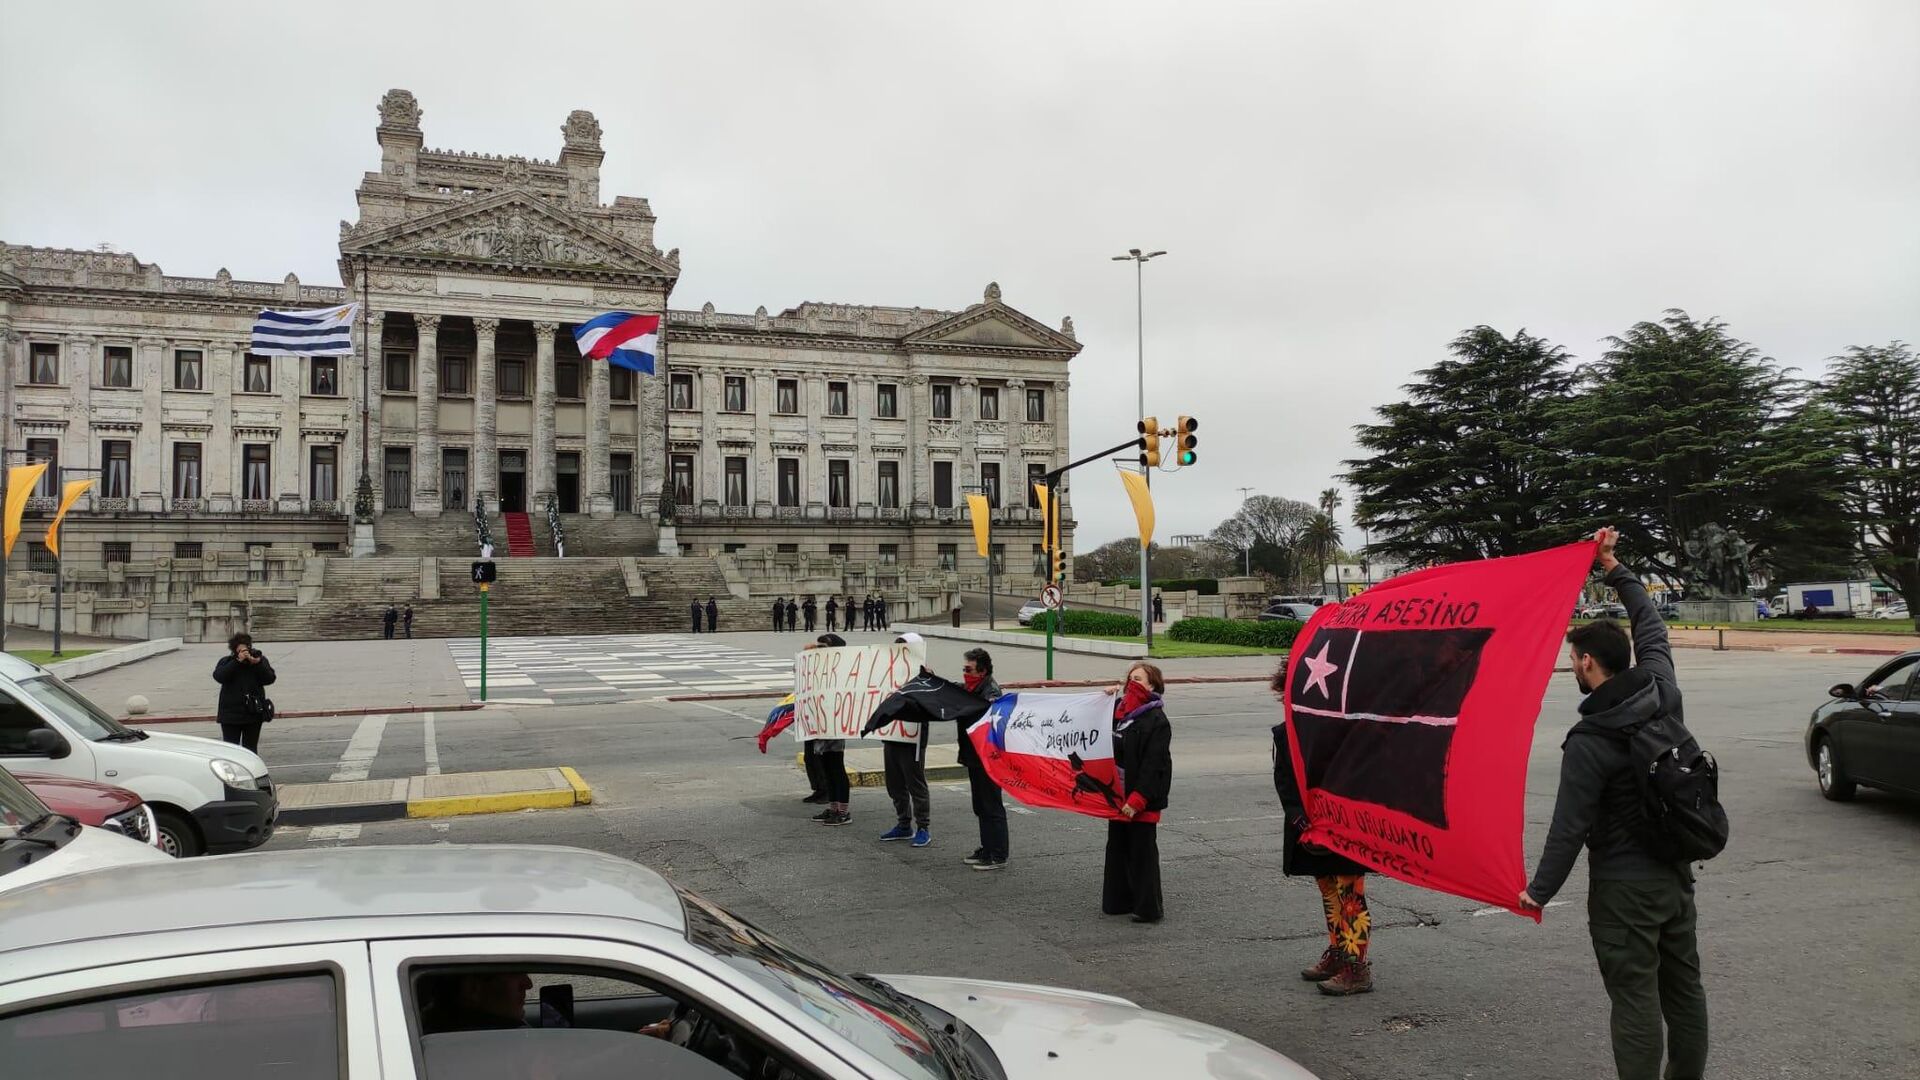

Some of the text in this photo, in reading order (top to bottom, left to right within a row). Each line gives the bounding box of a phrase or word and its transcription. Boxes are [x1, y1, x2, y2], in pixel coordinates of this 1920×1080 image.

[1373, 592, 1480, 626] ASESINO
[845, 650, 862, 689] A
[1046, 729, 1099, 753] DIGNIDAD
